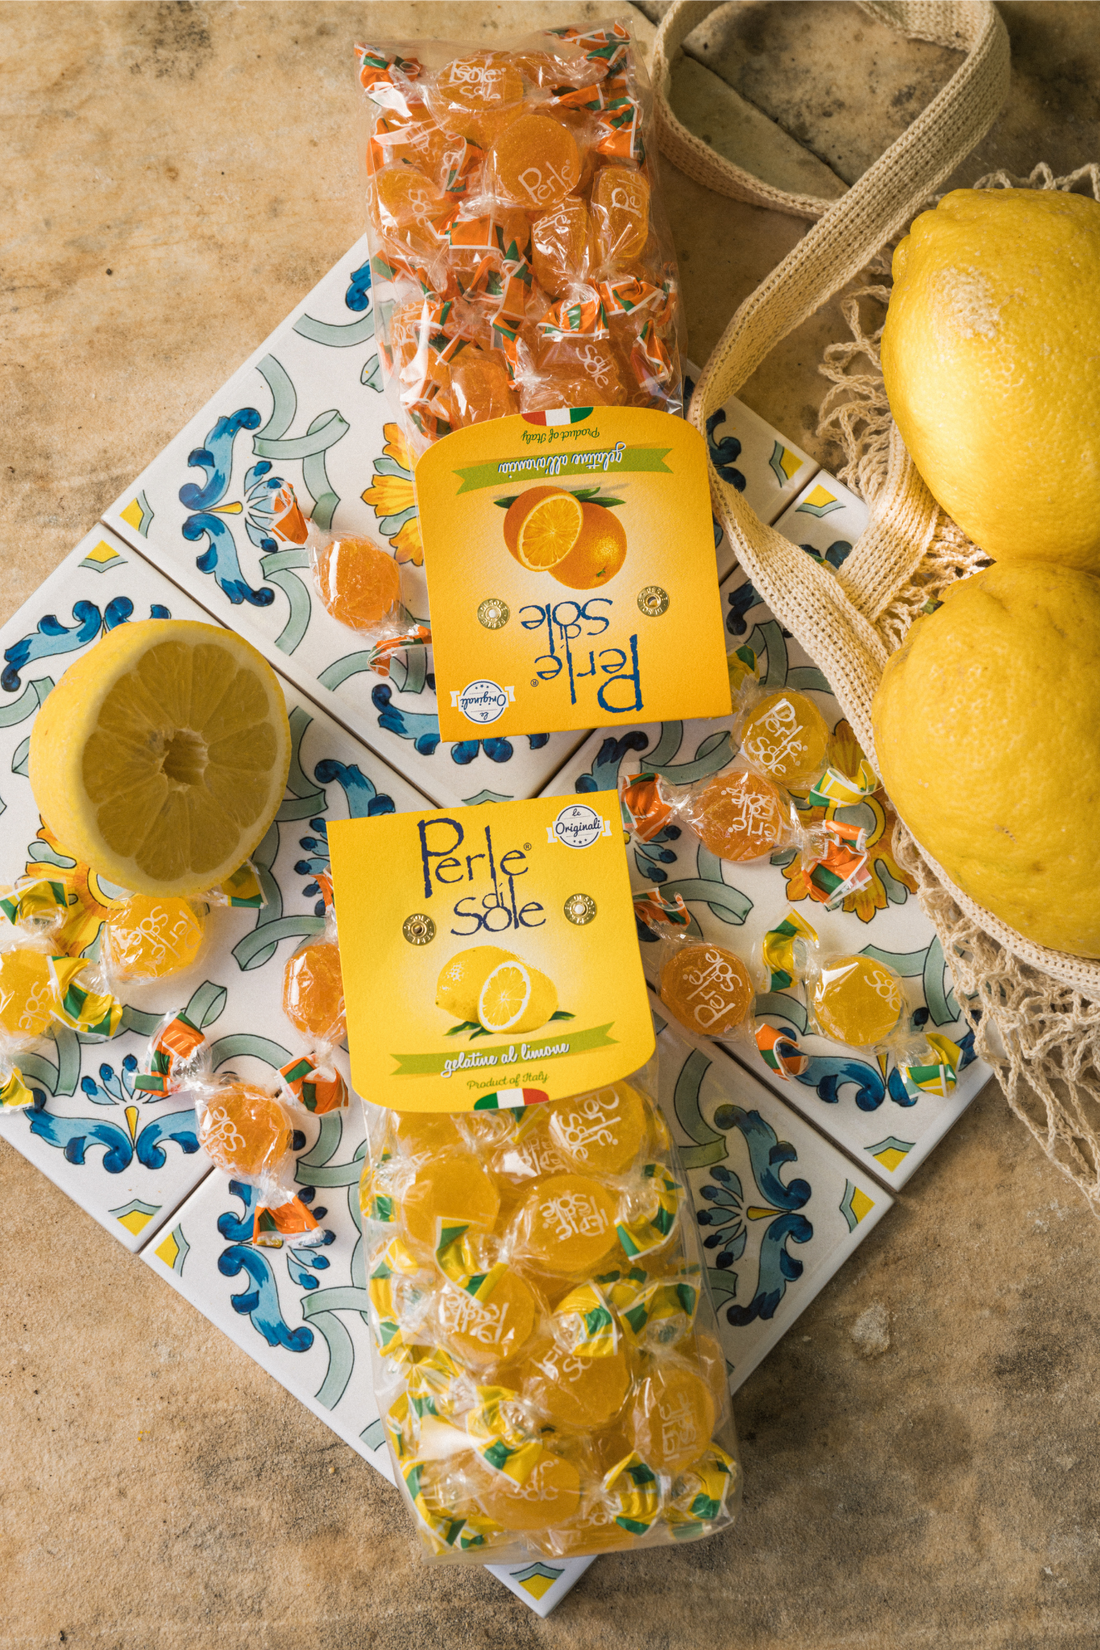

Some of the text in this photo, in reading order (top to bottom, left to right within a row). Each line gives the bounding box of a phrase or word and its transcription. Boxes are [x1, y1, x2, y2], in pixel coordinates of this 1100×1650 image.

[521, 427, 600, 444] Product of Italy
[497, 441, 627, 478] gelatine all'arancia
[460, 690, 507, 708] Originali
[555, 818, 602, 837] Originali
[440, 1042, 571, 1078] gelatine al limone
[466, 1070, 550, 1090] Product of Italy
